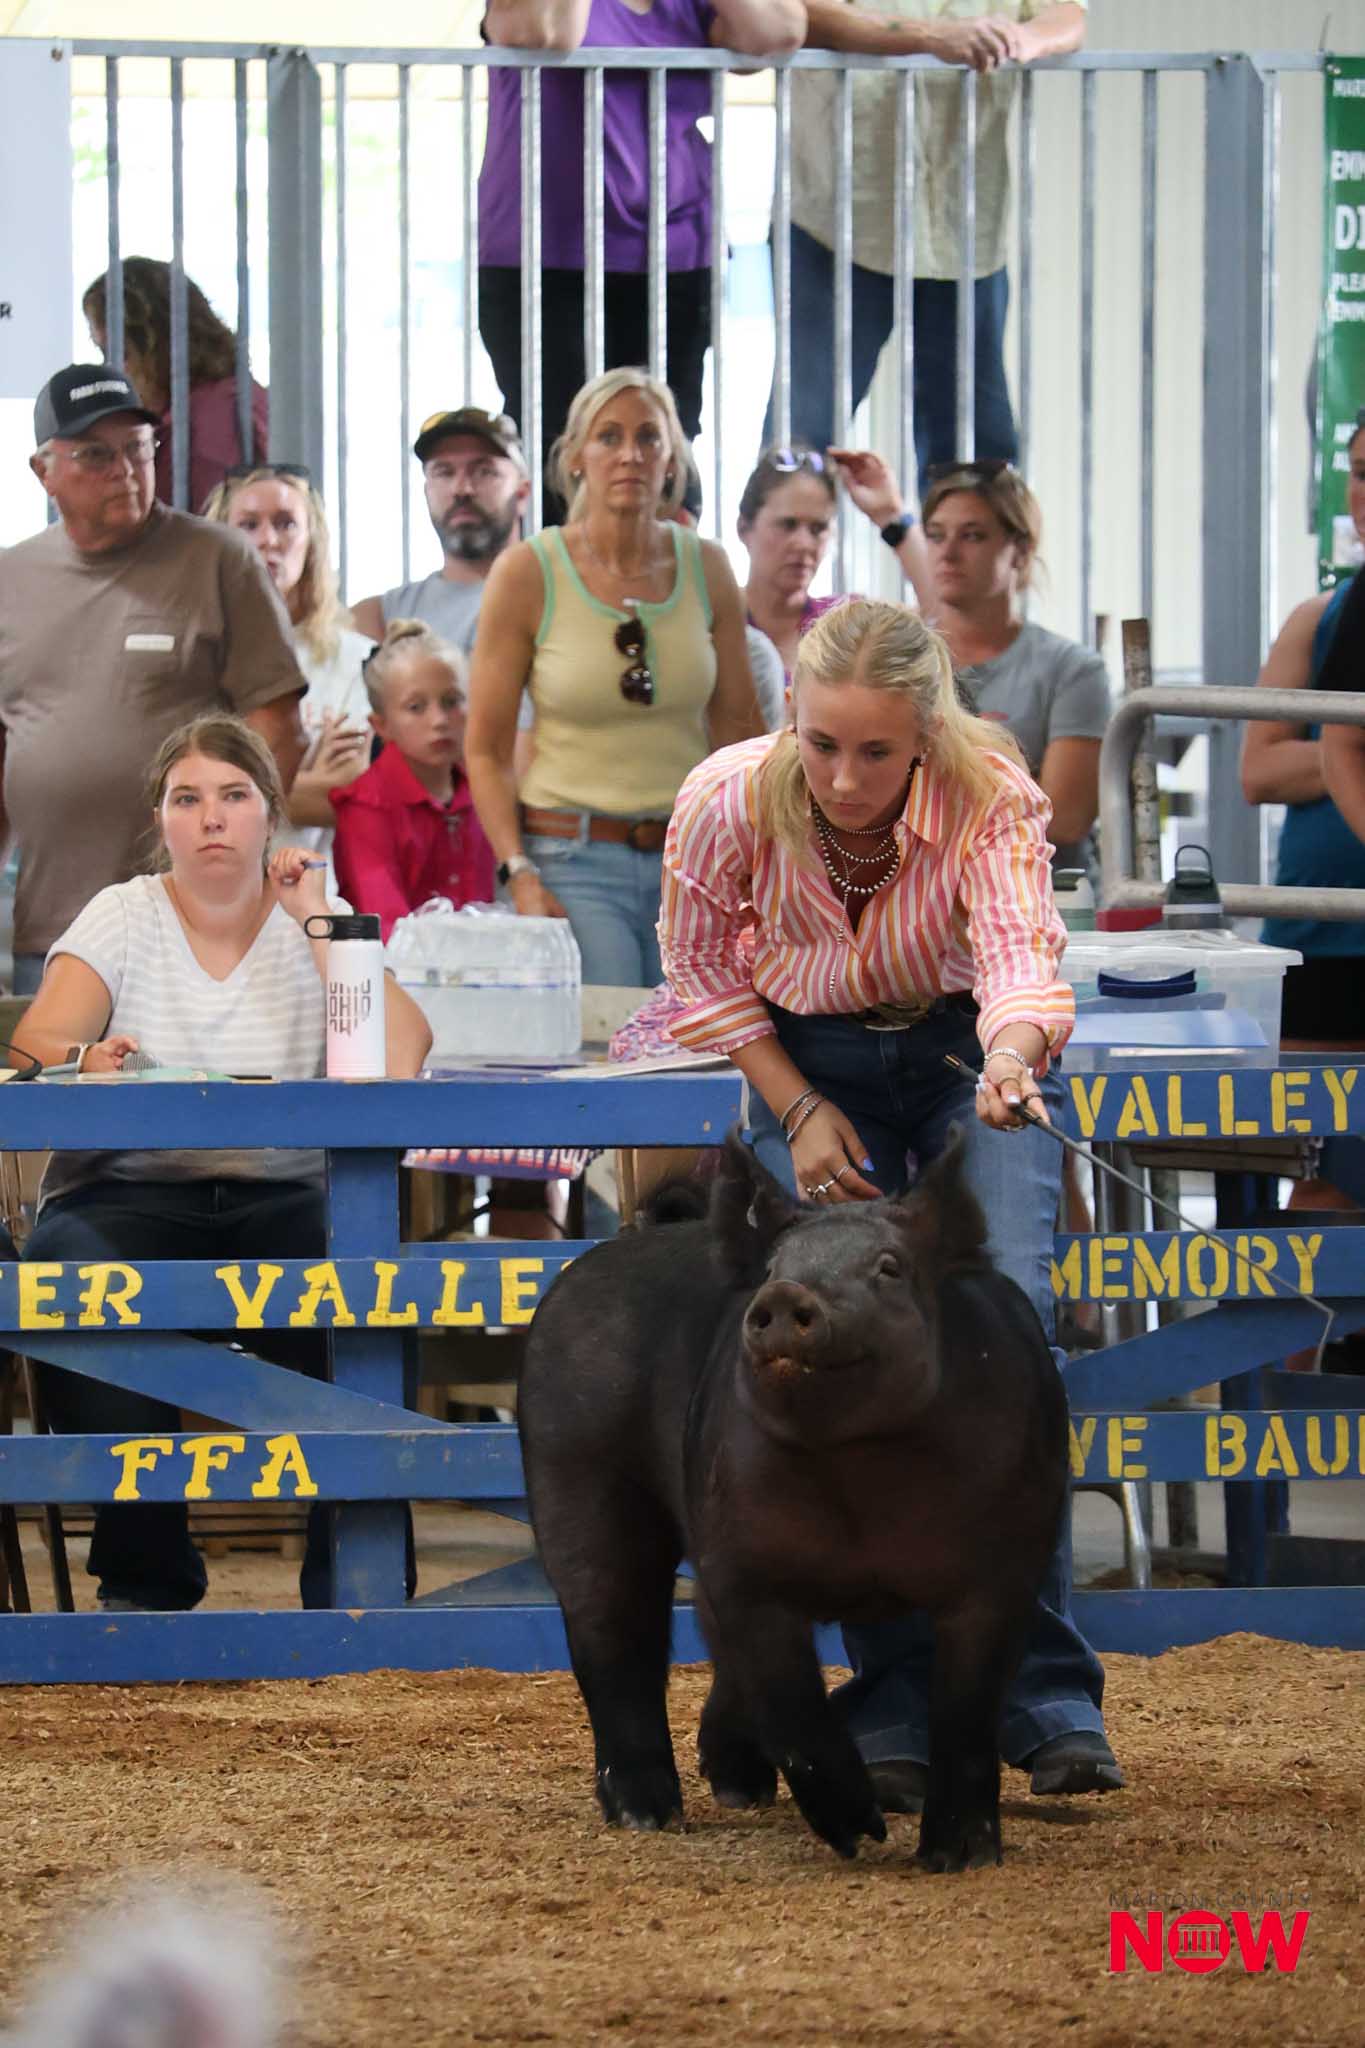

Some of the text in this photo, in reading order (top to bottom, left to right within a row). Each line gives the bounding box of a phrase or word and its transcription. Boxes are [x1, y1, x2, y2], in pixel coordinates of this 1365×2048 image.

[1071, 1069, 1357, 1137] VALLEY
[0, 1258, 573, 1329] ER VALLE
[1051, 1235, 1322, 1298] MEMORY
[111, 1433, 317, 1500] FFA
[1206, 1414, 1365, 1476] BAU
